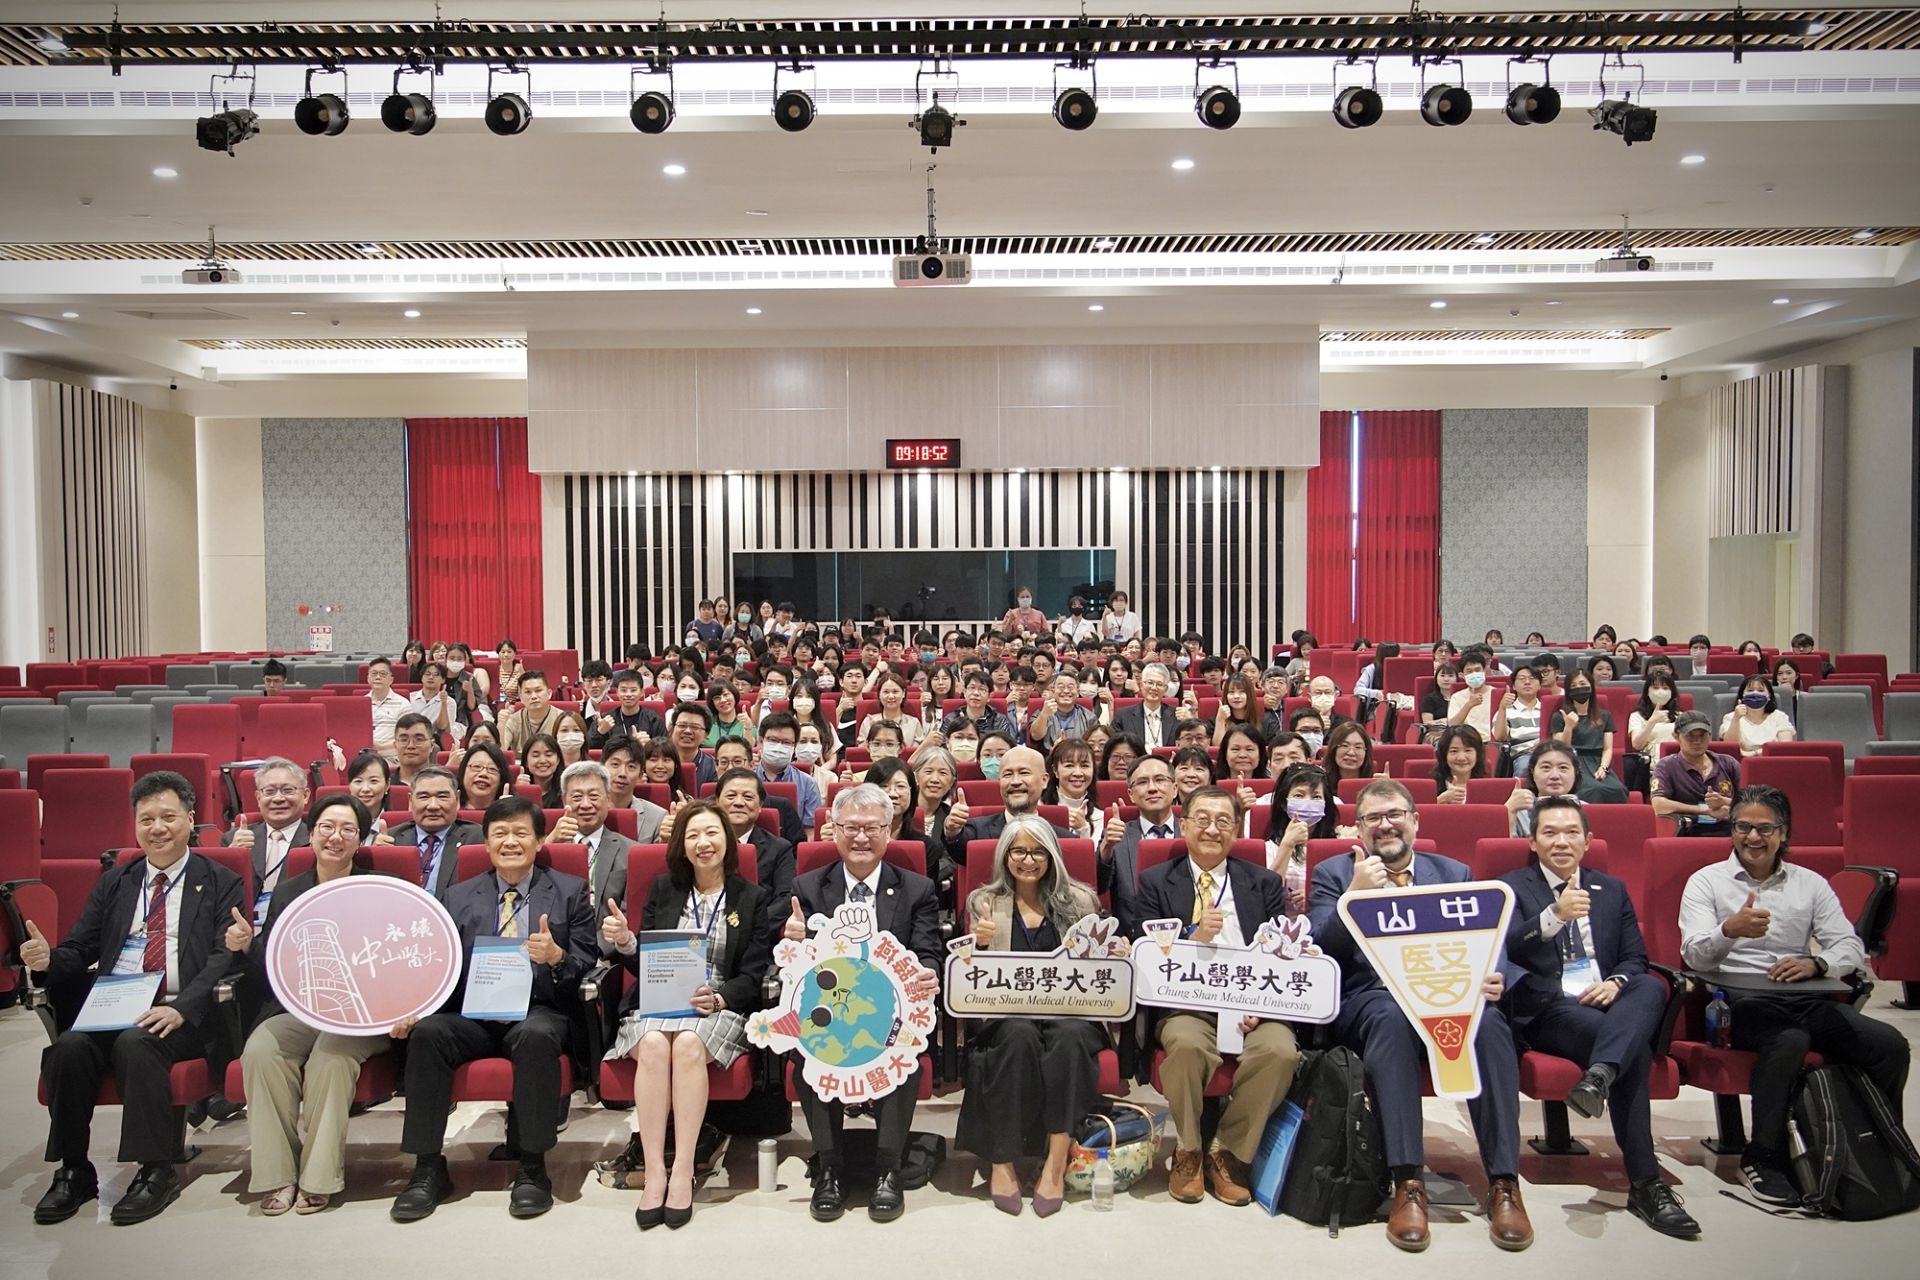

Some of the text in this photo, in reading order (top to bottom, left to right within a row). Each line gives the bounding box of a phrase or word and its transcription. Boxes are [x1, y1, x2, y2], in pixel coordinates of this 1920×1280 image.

[896, 445, 948, 461] 09:18:52
[384, 916, 434, 942] 永續
[965, 965, 1117, 995] 中山醫學大學
[1158, 957, 1313, 998] 中山醫學大學
[964, 993, 1116, 1010] Chung Shan Medical University
[1157, 985, 1313, 1014] Chung Shan Medical University
[818, 1053, 913, 1098] 中山醫大
